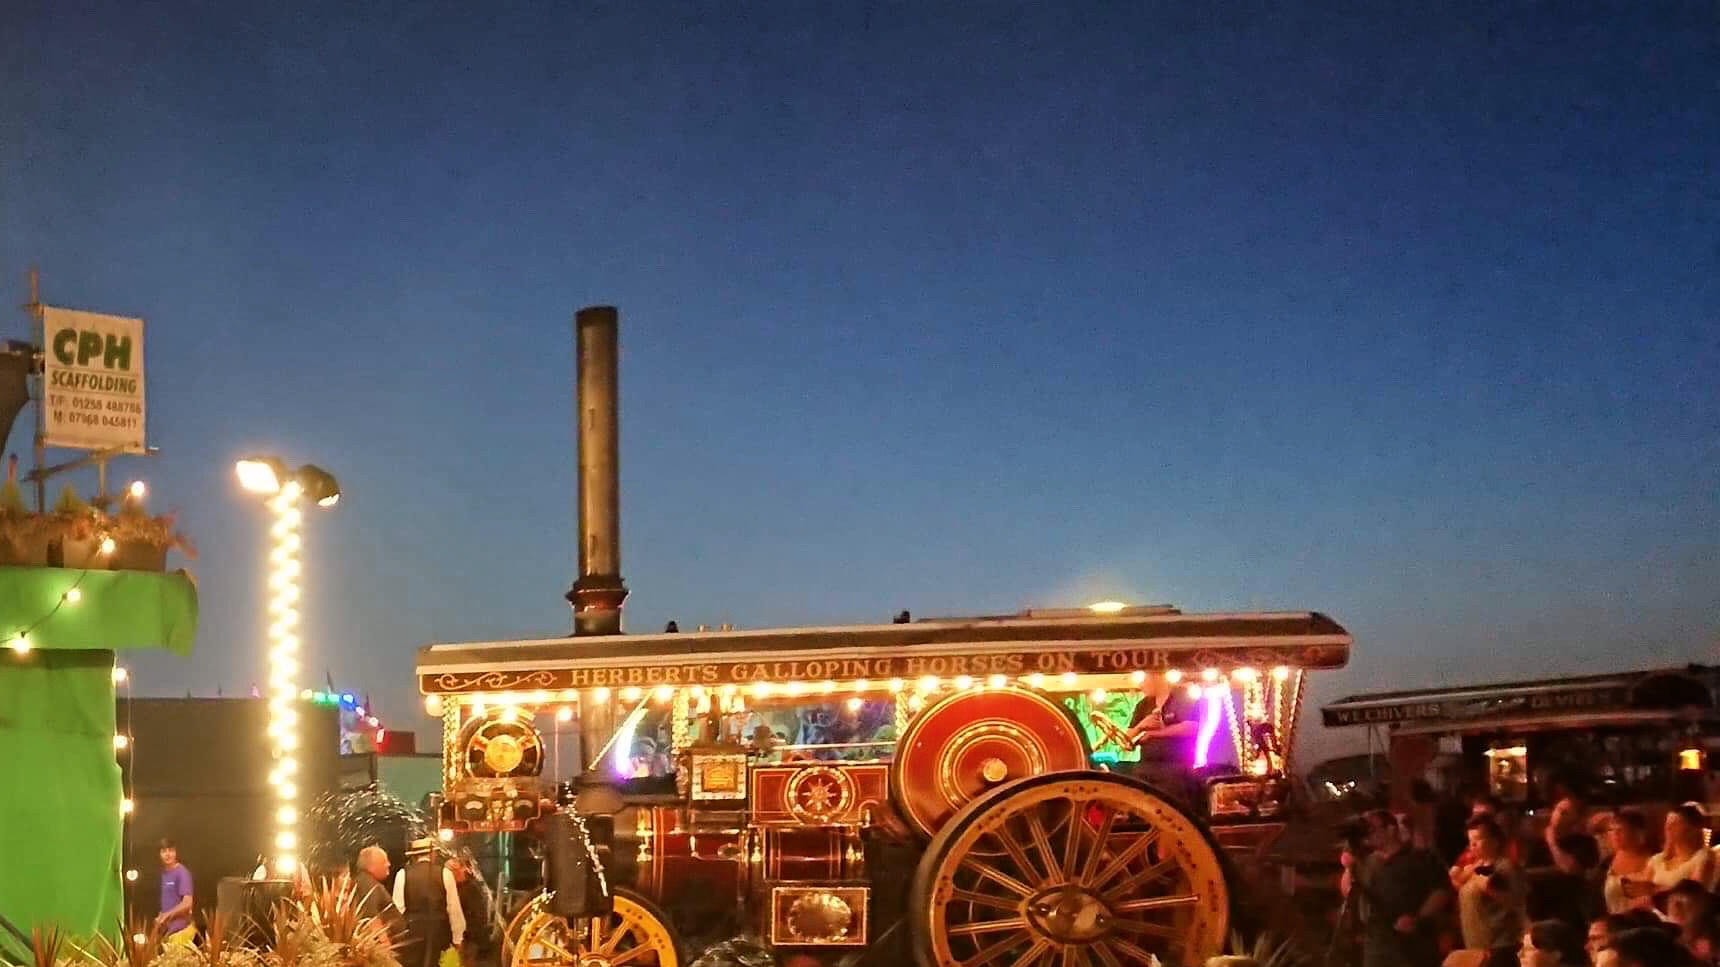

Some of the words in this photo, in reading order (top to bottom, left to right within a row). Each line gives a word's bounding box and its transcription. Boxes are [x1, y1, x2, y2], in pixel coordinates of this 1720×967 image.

[53, 328, 132, 371] CPH
[51, 369, 137, 394] SCAFFOLDING
[570, 664, 719, 686] HERBERTS
[730, 656, 891, 682] GALLOPING
[906, 653, 1024, 677] HORSES
[1037, 651, 1076, 672] ON
[1090, 649, 1170, 669] TOUR
